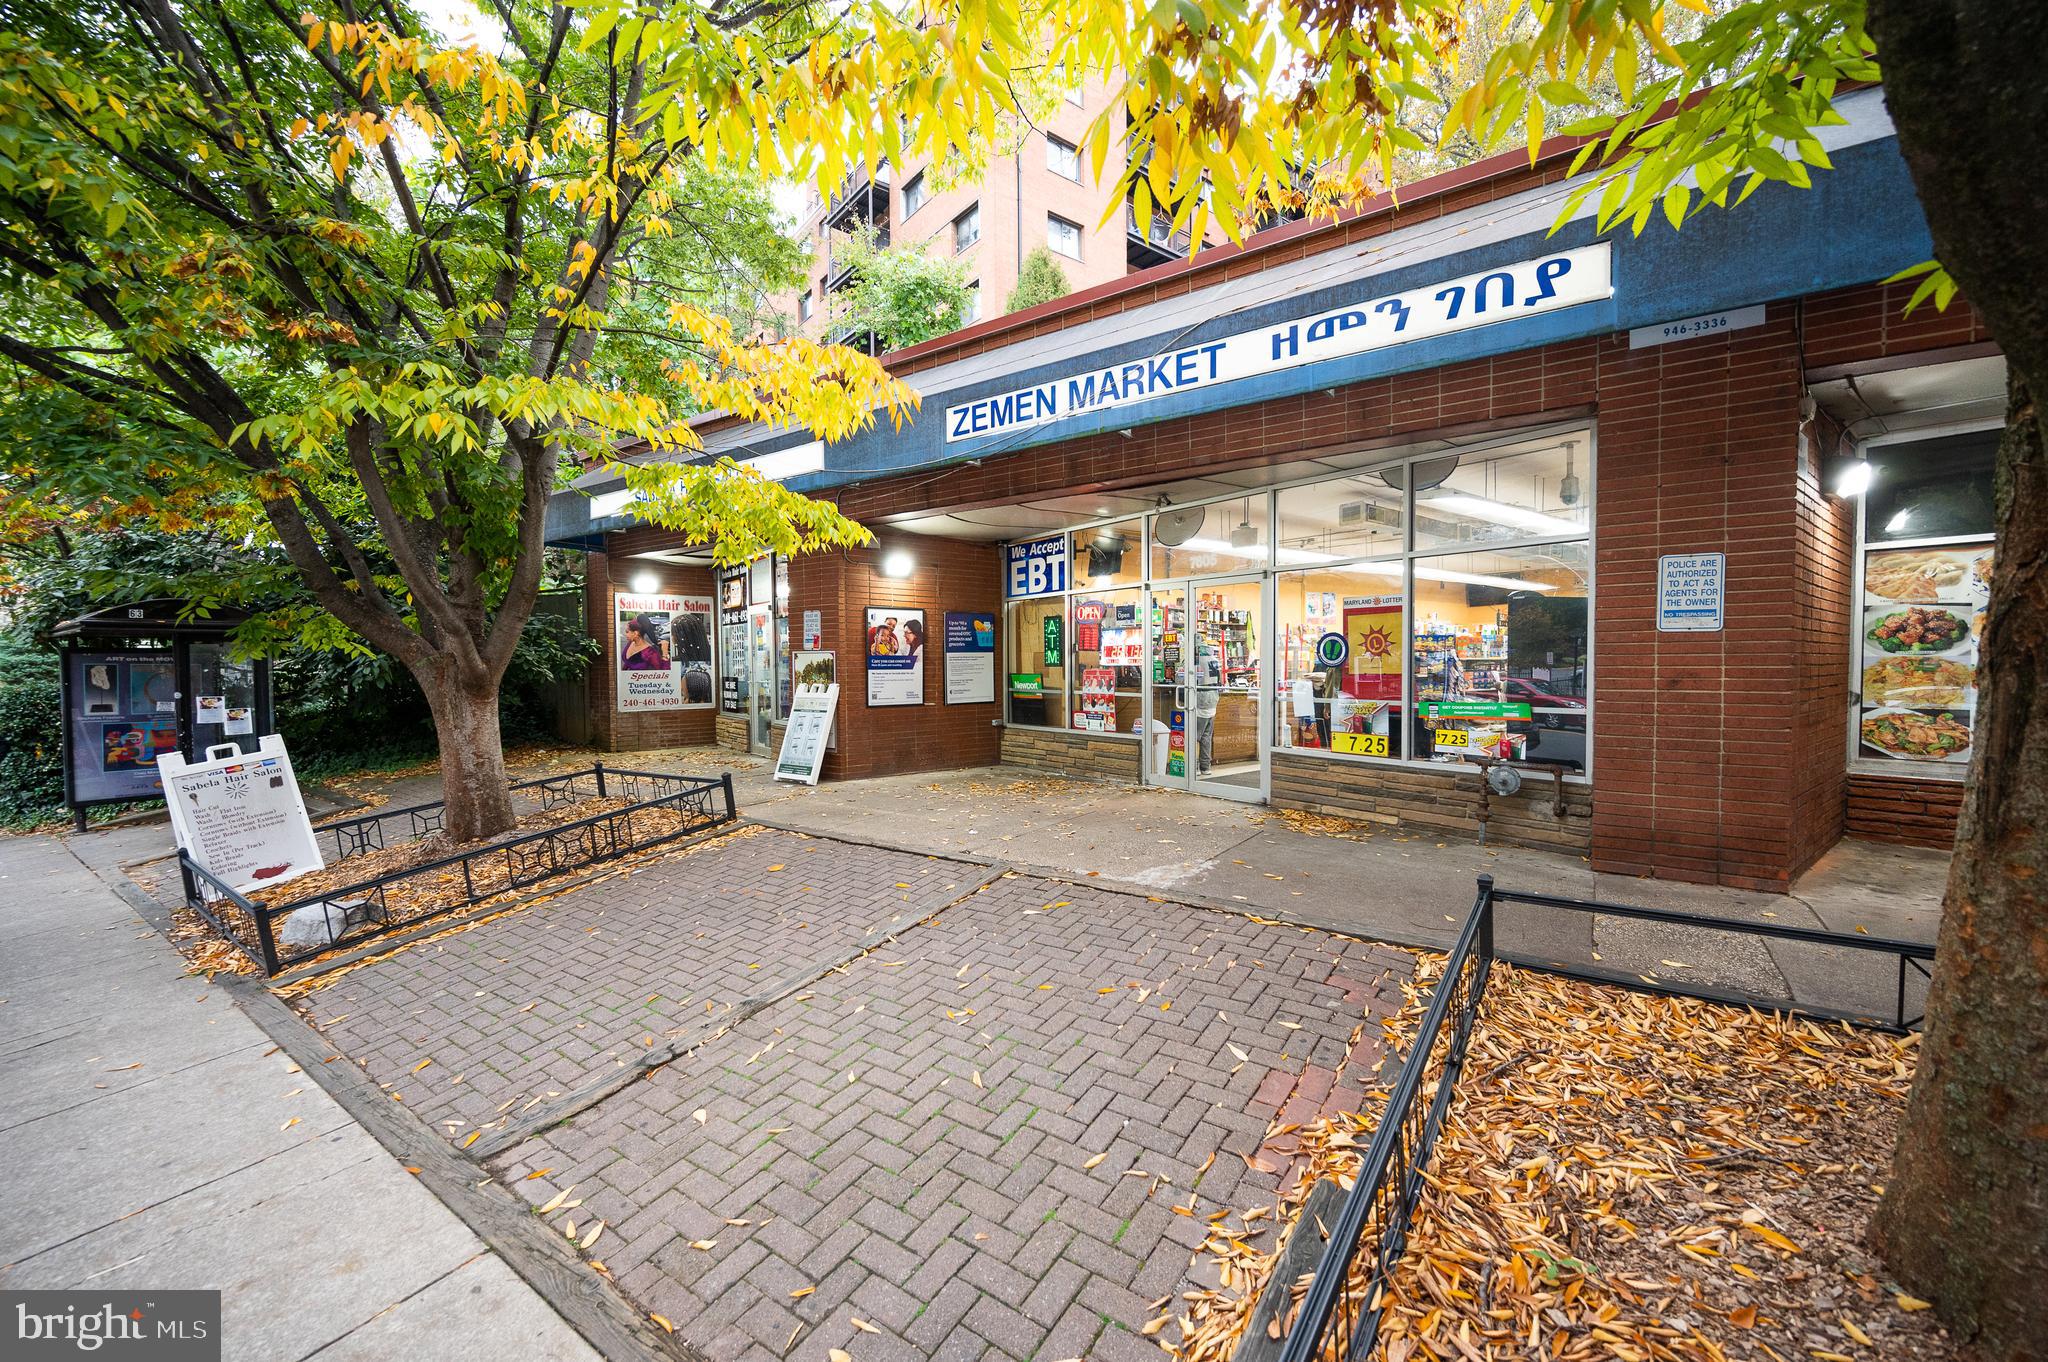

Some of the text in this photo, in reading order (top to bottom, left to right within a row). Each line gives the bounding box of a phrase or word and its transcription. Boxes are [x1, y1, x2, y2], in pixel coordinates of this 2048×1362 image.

[1272, 298, 1411, 361] ዘመን
[1663, 317, 1727, 336] 946-3336
[953, 343, 1226, 438] ZEMEN MARKET
[1011, 537, 1064, 558] We Accept
[1667, 559, 1717, 569] POLICE ARE
[1010, 553, 1065, 596] EBT
[1667, 569, 1717, 578] AUTHORIZED
[1665, 588, 1718, 597] AGENTS FOR
[658, 600, 680, 610] Hair
[684, 600, 710, 612] Salon
[1344, 598, 1372, 606] MARYLAND
[1685, 598, 1717, 606] OWNER
[1076, 606, 1102, 620] OPEN
[1048, 620, 1059, 663] ATM
[630, 672, 669, 681] Specials
[1014, 680, 1039, 690] Newport
[623, 698, 679, 707] 240-461-4930
[1350, 735, 1385, 753] 7.25
[182, 767, 283, 793] Sabela Hair Salon
